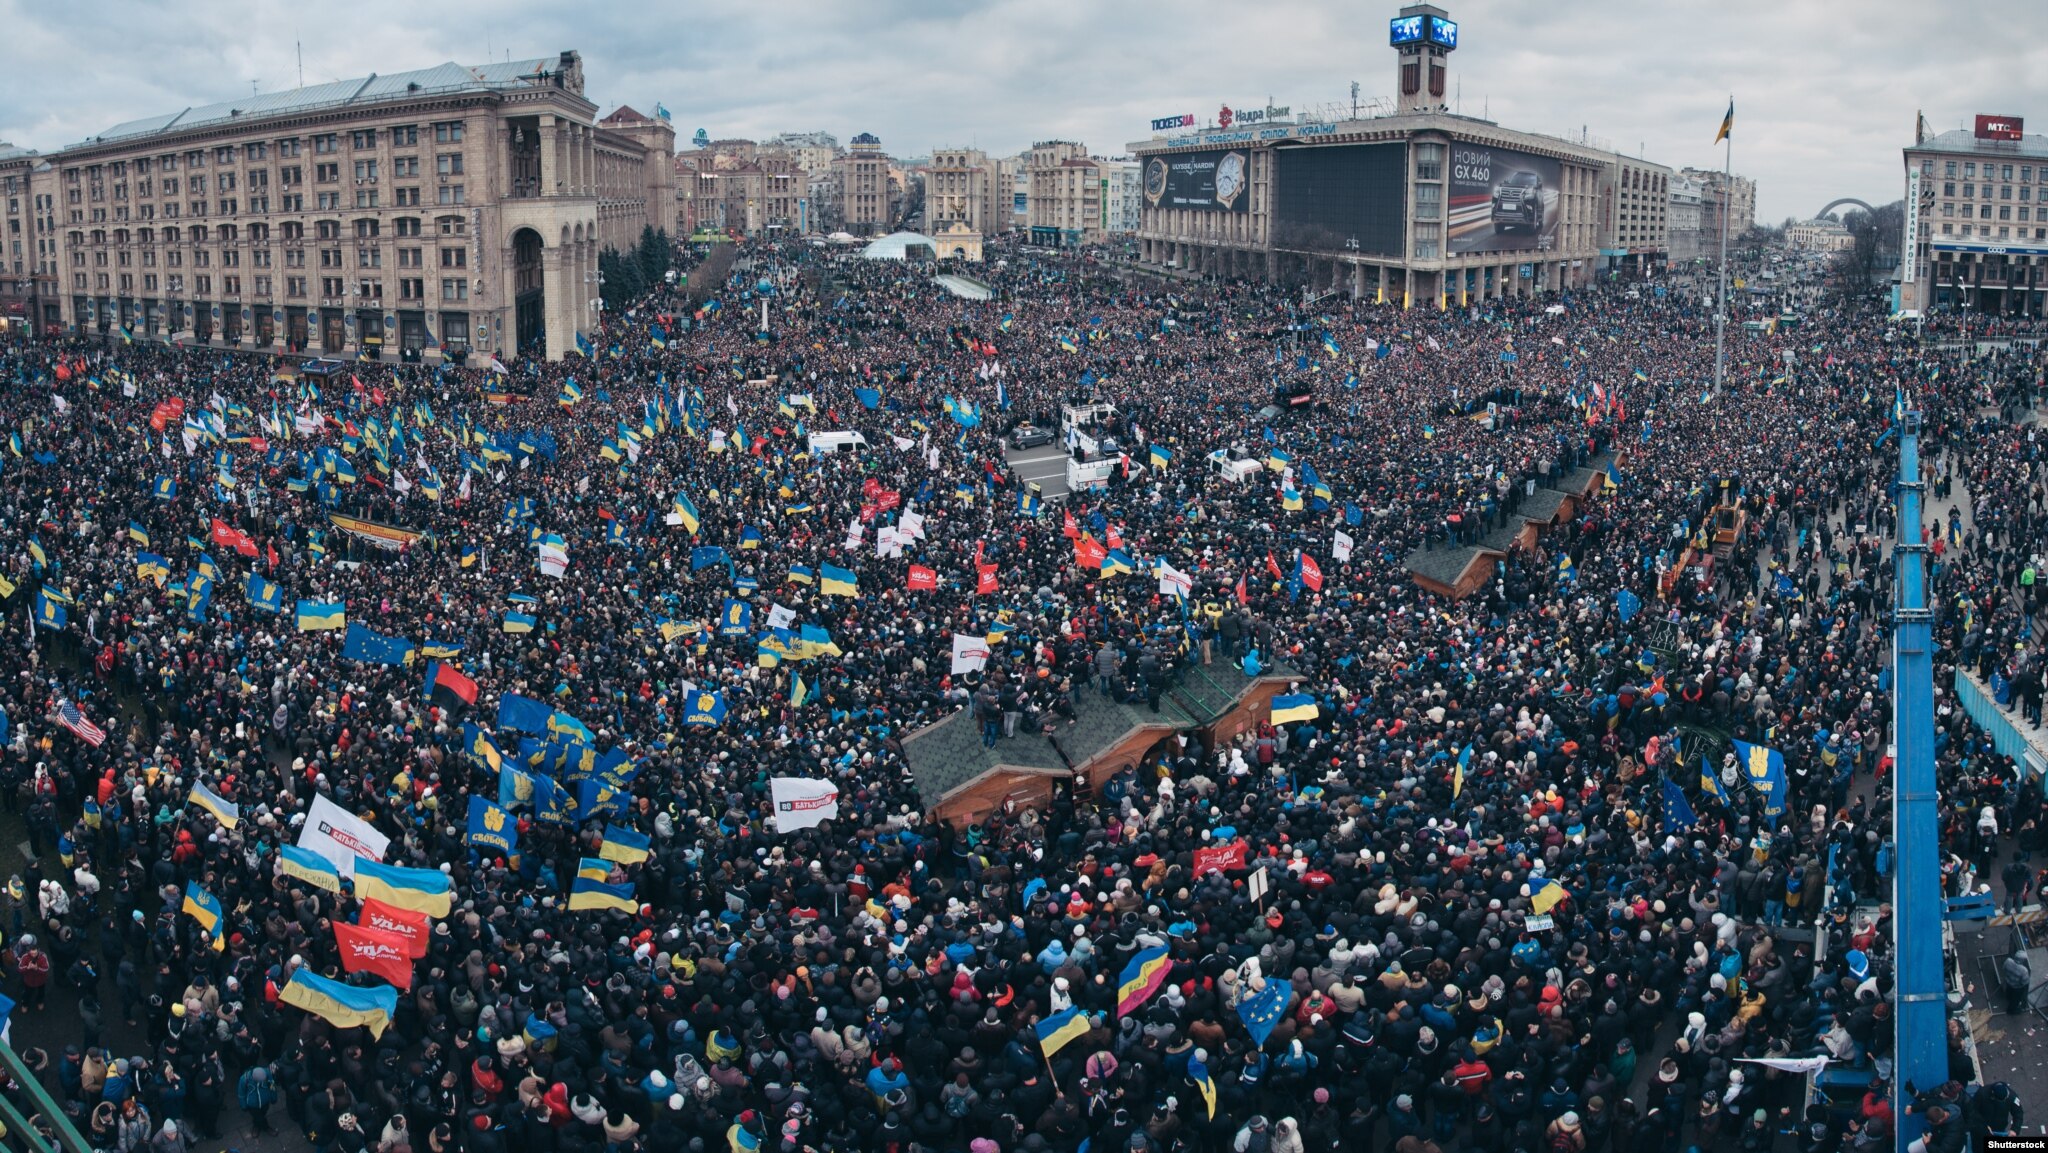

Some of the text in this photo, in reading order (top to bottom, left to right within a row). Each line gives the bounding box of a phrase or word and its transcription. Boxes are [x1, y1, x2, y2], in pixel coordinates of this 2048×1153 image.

[1235, 105, 1290, 122] Надра Банк
[1297, 123, 1336, 136] УКРАЇНИ
[1172, 161, 1214, 170] ULYSSE NARDIN
[1454, 149, 1491, 166] НОВИЙ
[1454, 164, 1490, 181] GX 460
[1909, 183, 1917, 240] СБЕРБАНК
[319, 822, 332, 834] ВО
